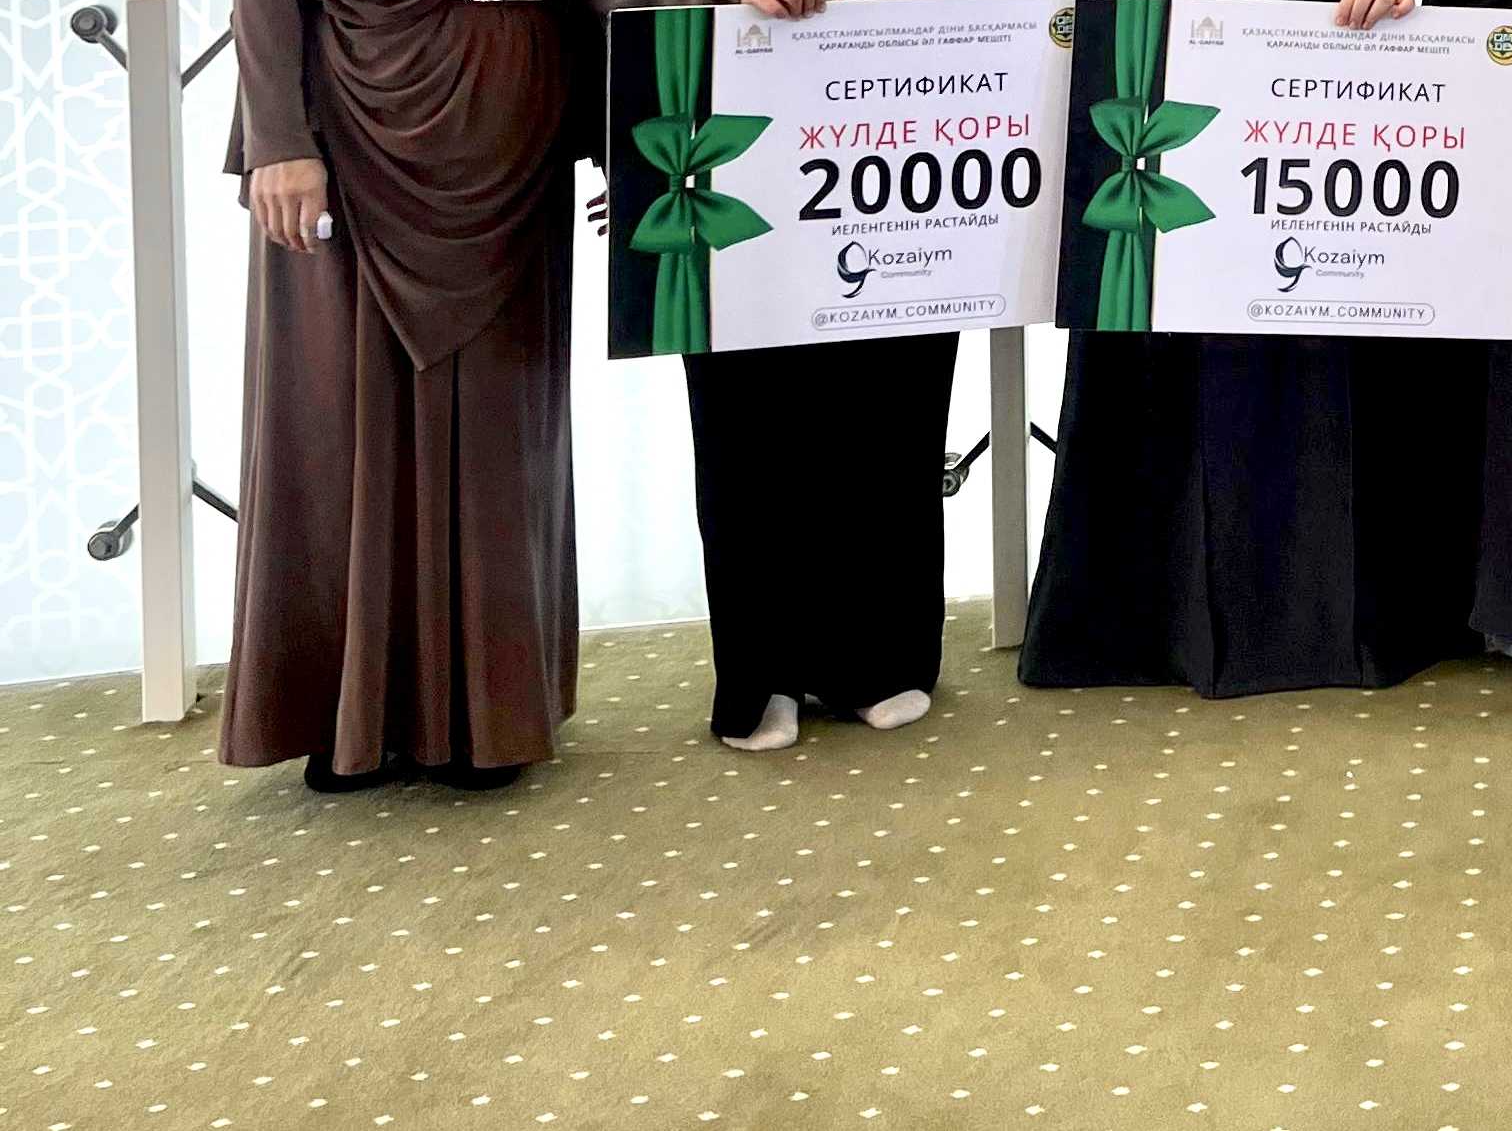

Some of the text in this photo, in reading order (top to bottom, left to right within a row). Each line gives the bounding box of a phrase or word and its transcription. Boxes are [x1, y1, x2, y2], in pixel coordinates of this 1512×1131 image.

[826, 73, 1009, 101] СЕРТИФИКАТ
[1271, 79, 1446, 102] СЕРТИФИКАТ
[800, 114, 1030, 150] ЖҮЛДЕ ҚОРЫ
[1244, 120, 1465, 152] ЖҮЛДЕ ҚОРЫ
[799, 148, 1042, 221] 20000
[1241, 157, 1460, 218] 15000
[831, 213, 999, 236] ИЕЛЕНГЕНІН РАСТАЙДЫ
[1271, 219, 1432, 236] ИЕЛЕНГЕНІН РАСТАЙДЫ
[868, 247, 952, 266] Kozaiym
[1304, 246, 1385, 269] Kozaiym
